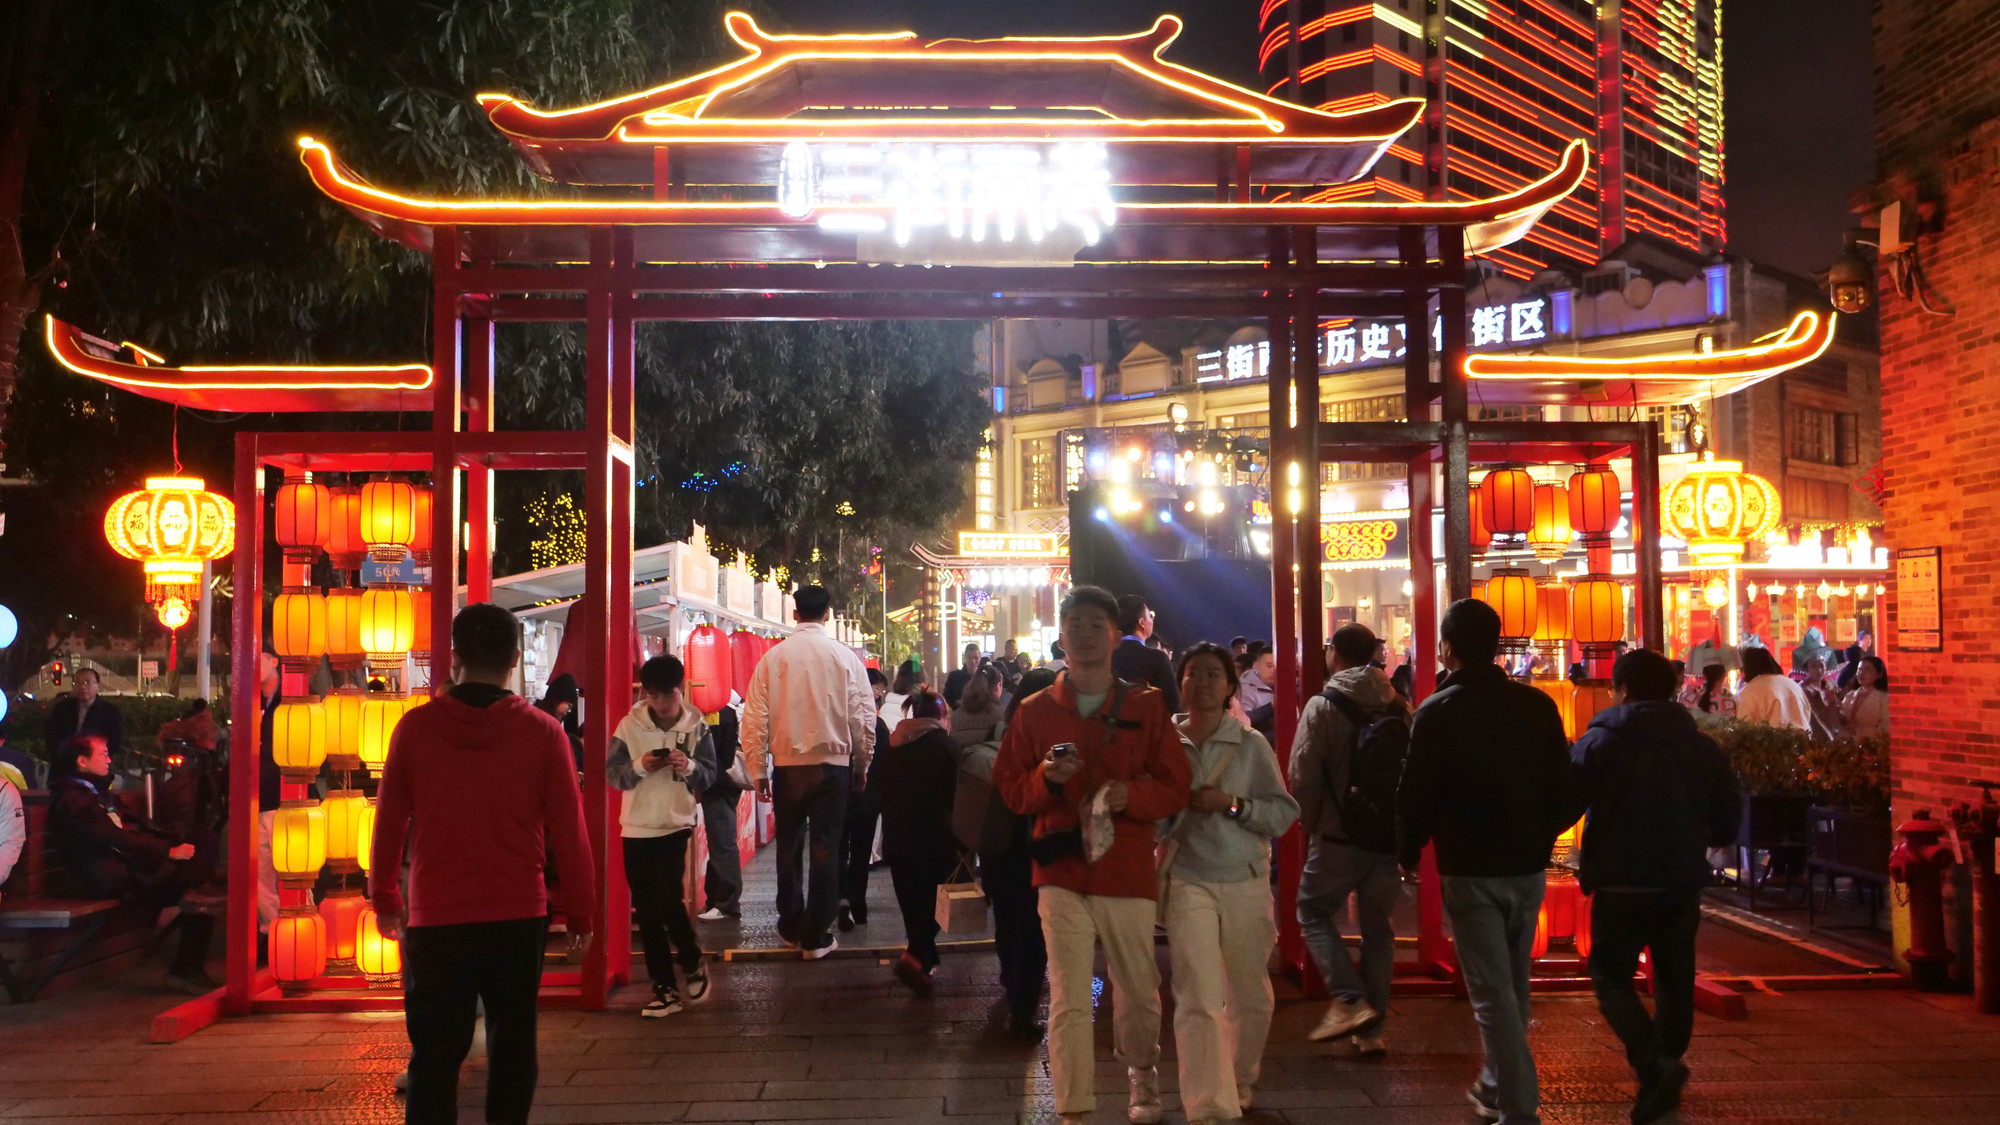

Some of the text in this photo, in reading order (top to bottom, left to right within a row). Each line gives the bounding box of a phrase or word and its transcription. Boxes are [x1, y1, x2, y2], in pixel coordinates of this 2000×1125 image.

[1197, 299, 1546, 383] 三街历史街区
